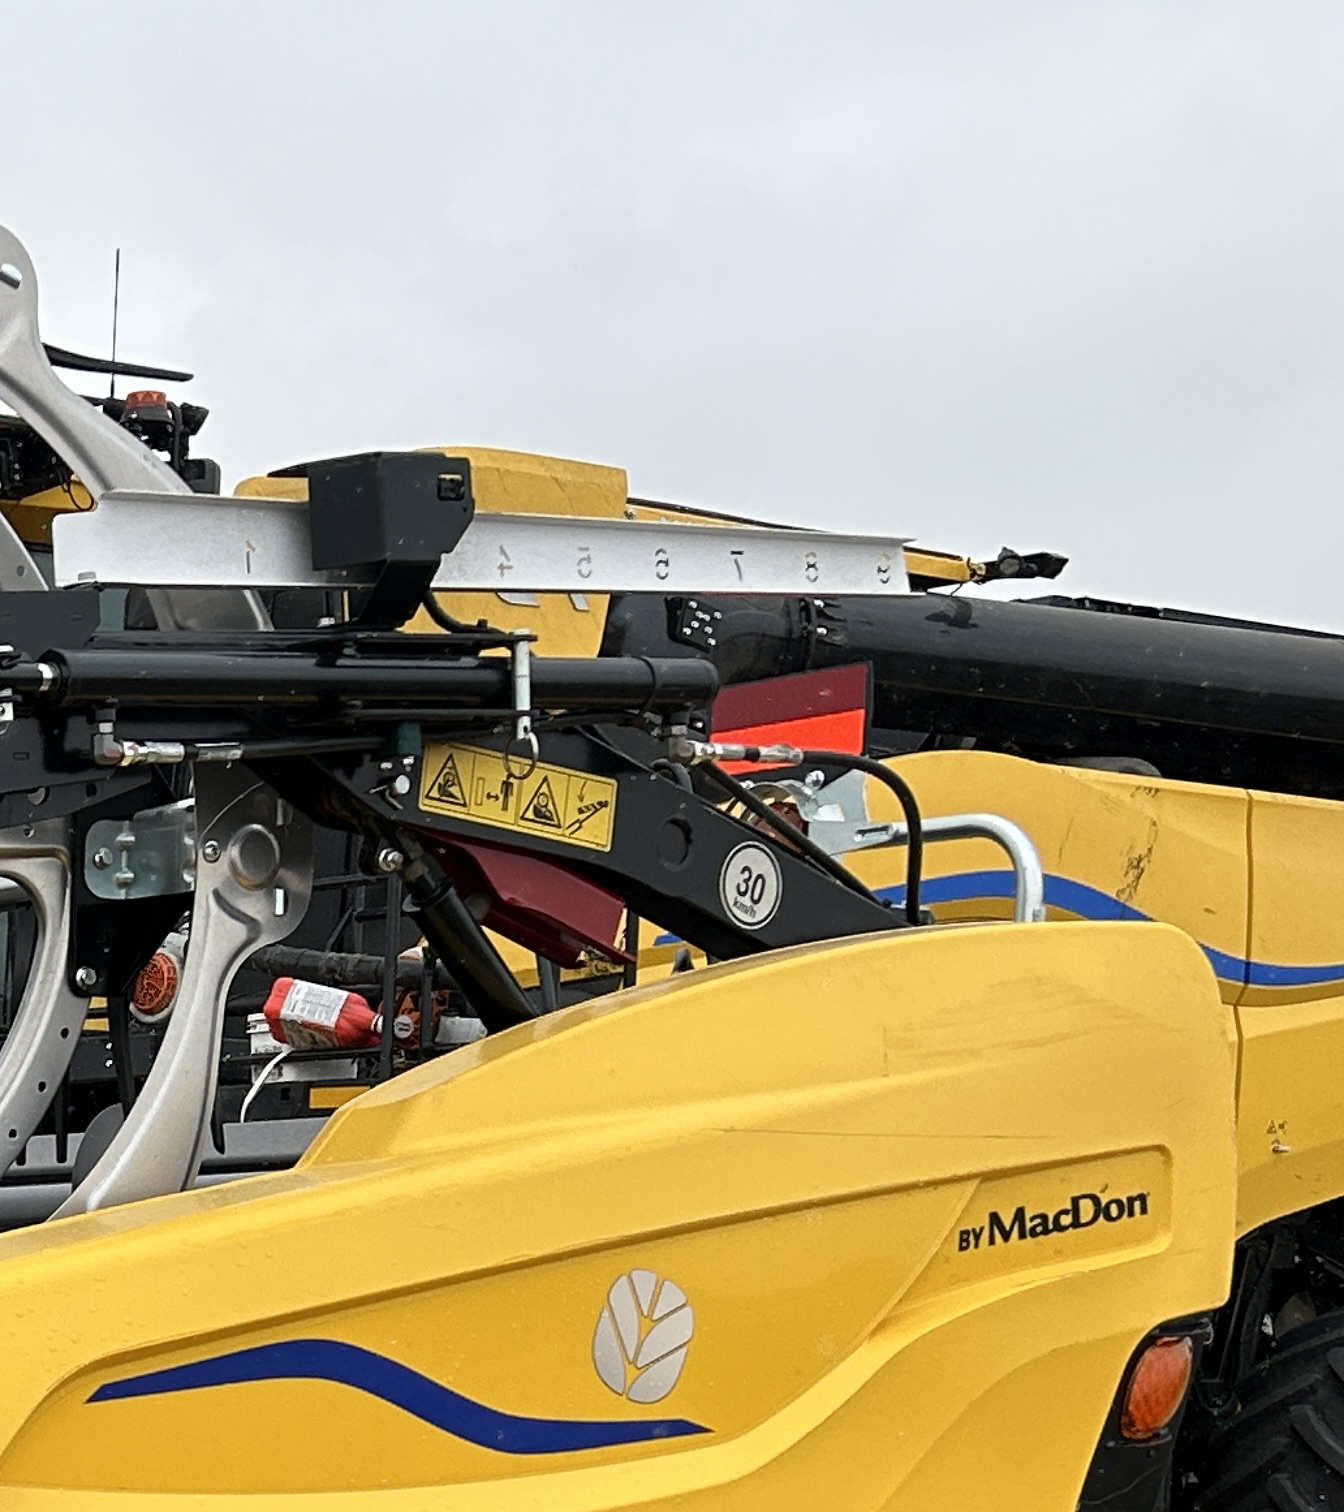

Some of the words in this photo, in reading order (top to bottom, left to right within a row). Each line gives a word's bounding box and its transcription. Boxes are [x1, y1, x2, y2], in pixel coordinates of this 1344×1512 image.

[737, 866, 766, 905] 30
[957, 1225, 985, 1253] BY
[987, 1191, 1149, 1247] MacDon
